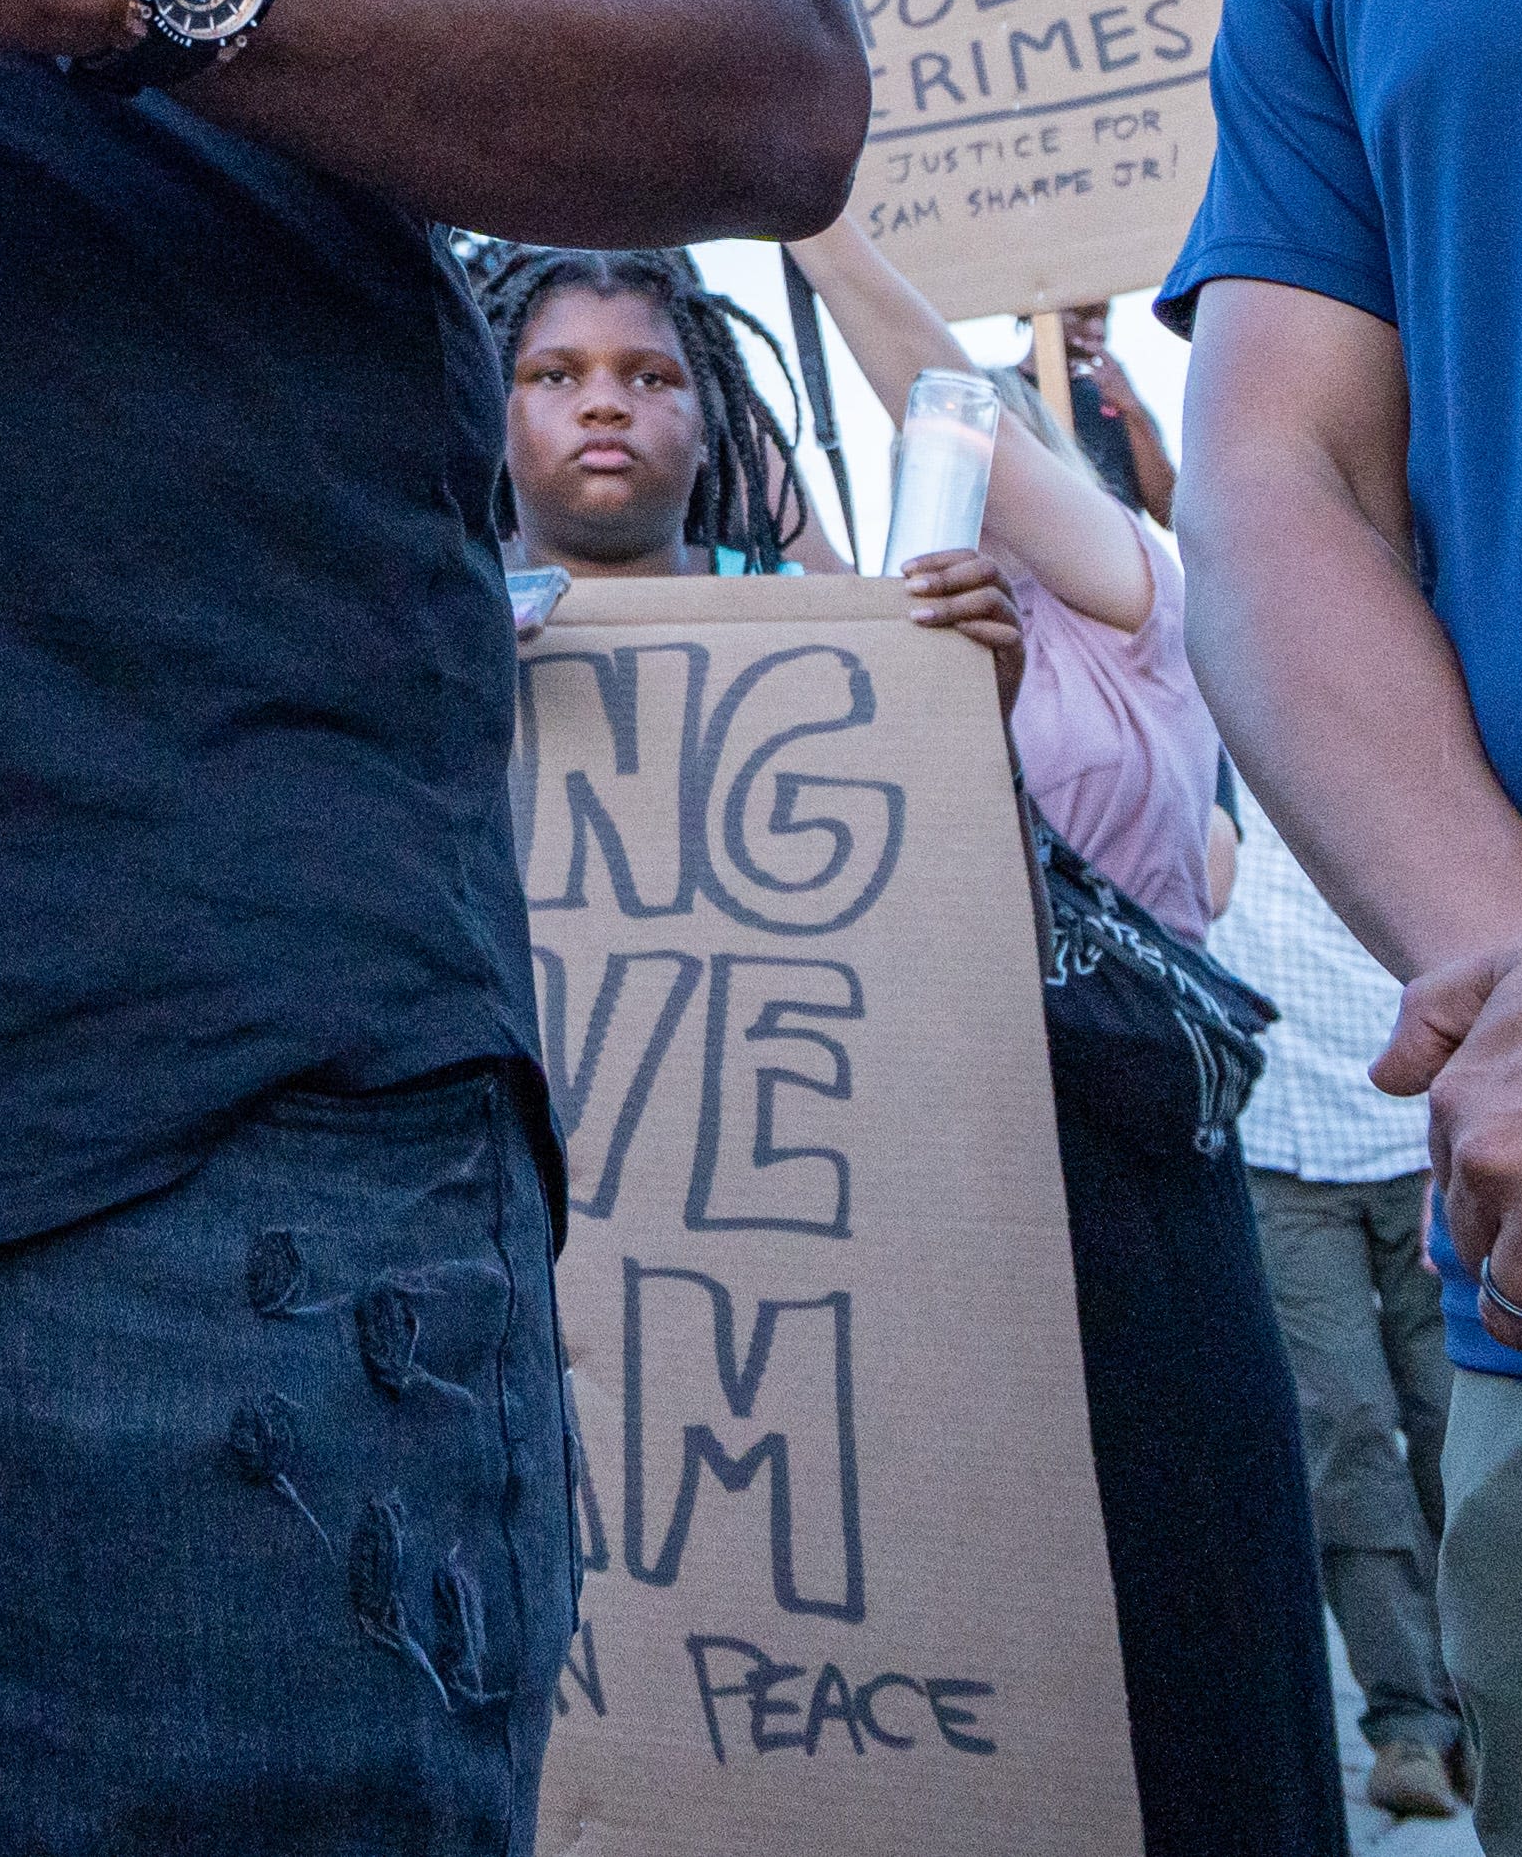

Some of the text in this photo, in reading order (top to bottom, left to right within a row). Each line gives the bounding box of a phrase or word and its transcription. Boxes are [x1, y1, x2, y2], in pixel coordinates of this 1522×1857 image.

[868, 197, 941, 241] SAM
[966, 168, 1095, 217] SHARPE
[889, 109, 1162, 184] JUSTICE FOR
[515, 642, 906, 935] NG
[531, 945, 865, 1239] VE
[686, 1633, 998, 1766] PEACE
